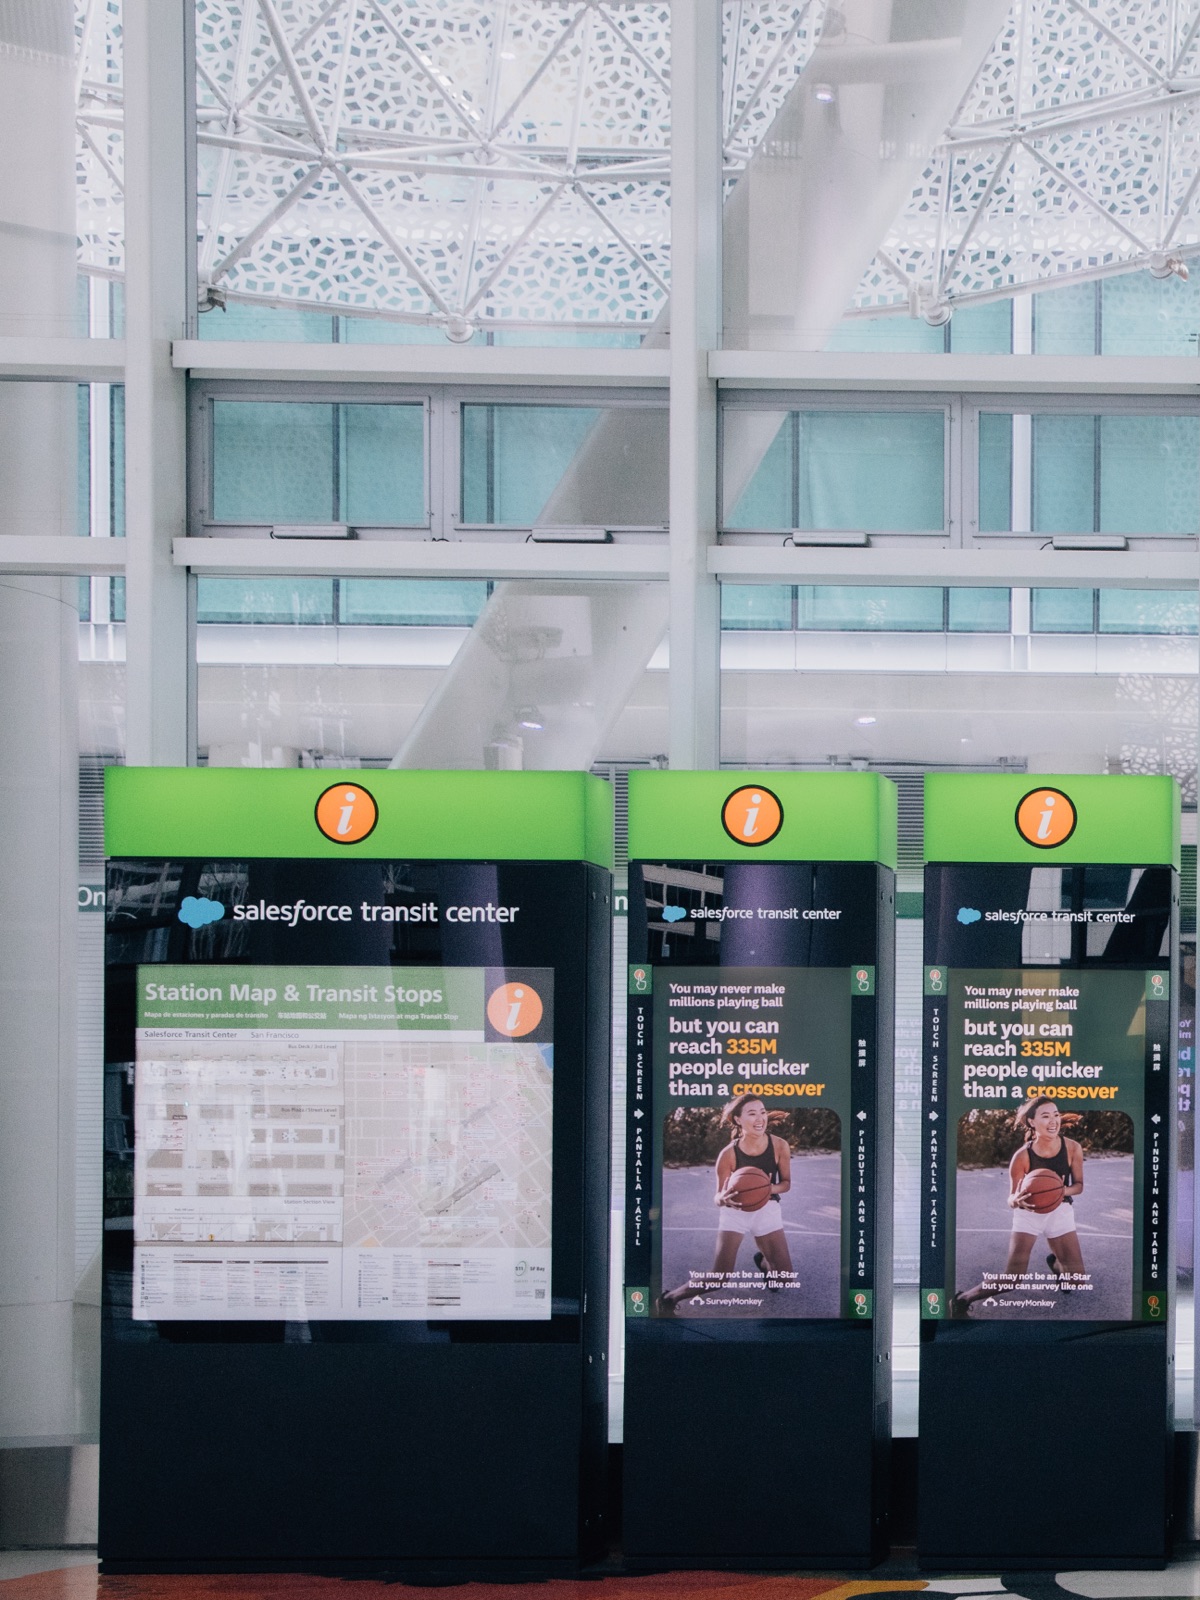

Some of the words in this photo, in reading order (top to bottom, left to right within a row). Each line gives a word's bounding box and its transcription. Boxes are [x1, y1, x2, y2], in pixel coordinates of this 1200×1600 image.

[234, 900, 352, 926] salesforce
[360, 902, 438, 921] transit
[446, 903, 519, 922] center
[691, 907, 753, 921] salesforce
[757, 907, 798, 919] transit
[803, 908, 841, 919] center
[985, 909, 1047, 924] salesforce
[1051, 911, 1092, 923] transit
[1096, 912, 1136, 923] center
[146, 983, 221, 1000] Station
[231, 984, 277, 1005] Map
[284, 984, 299, 1001] &
[306, 984, 378, 1002] Transit
[384, 985, 442, 1006] Stops
[670, 984, 690, 993] You
[694, 986, 717, 995] may
[754, 984, 785, 994] make
[670, 997, 715, 1006] millions
[718, 997, 759, 1009] playing
[761, 997, 783, 1007] ball
[266, 1031, 300, 1039] Francisco
[670, 1017, 702, 1033] but
[706, 1021, 740, 1039] you
[745, 1021, 779, 1033] can
[965, 1019, 997, 1035] but
[1001, 1024, 1035, 1041] you
[1039, 1024, 1072, 1036] can
[670, 1038, 722, 1054] reach
[727, 1039, 776, 1054] 335M
[965, 1040, 1016, 1056] reach
[1021, 1041, 1070, 1056] 335M
[670, 1059, 734, 1079] people
[738, 1059, 809, 1078] quicker
[964, 1061, 1028, 1081] people
[1032, 1061, 1103, 1080] quicker
[669, 1079, 712, 1095] than
[718, 1084, 729, 1095] a
[733, 1084, 825, 1096] crossover
[963, 1081, 1006, 1097] than
[1011, 1086, 1023, 1098] a
[1027, 1086, 1118, 1099] crossover
[706, 1272, 724, 1280] may
[739, 1282, 766, 1290] survey
[706, 1298, 762, 1306] SurveyMonkey
